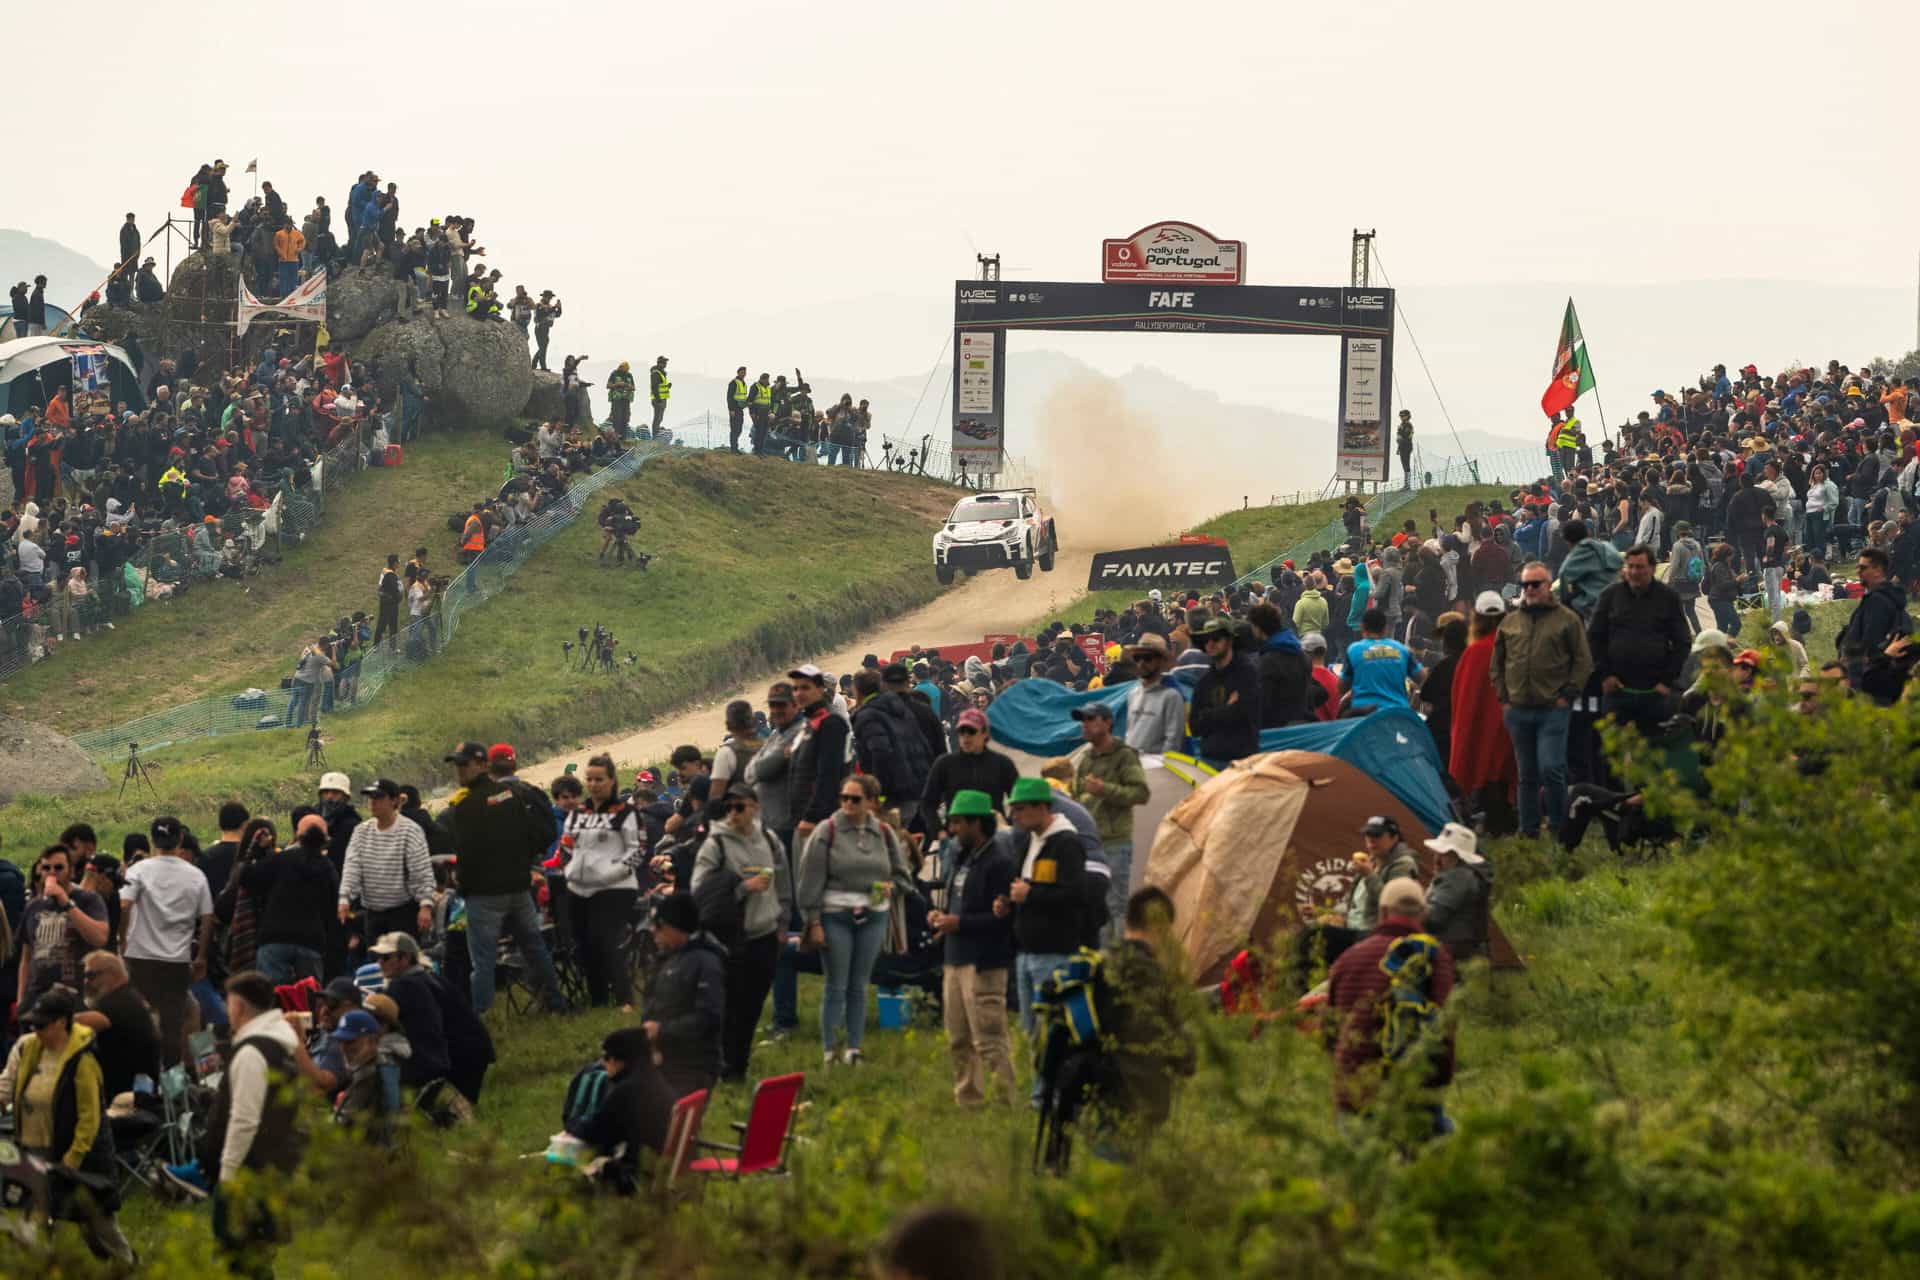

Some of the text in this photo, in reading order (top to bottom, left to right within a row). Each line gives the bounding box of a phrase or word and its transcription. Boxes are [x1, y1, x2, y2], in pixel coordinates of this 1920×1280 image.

[1147, 246, 1174, 255] rally
[1145, 255, 1221, 268] Portugal
[960, 289, 997, 298] WRC
[1149, 292, 1194, 307] FAFE
[1347, 295, 1384, 304] WRC
[1102, 561, 1222, 577] FANATEC
